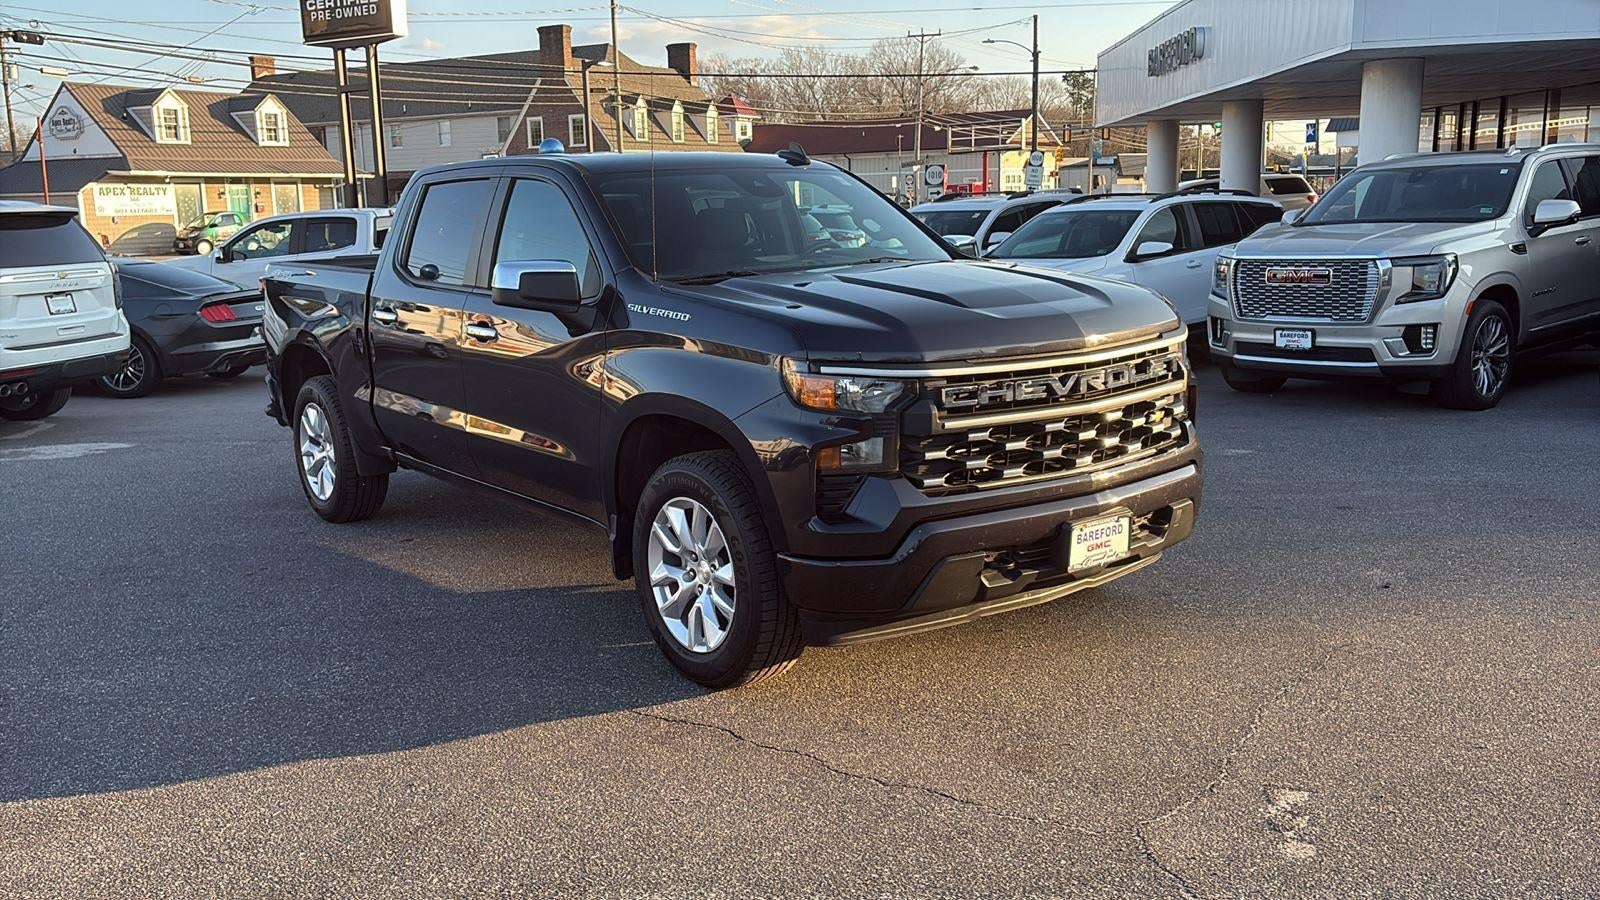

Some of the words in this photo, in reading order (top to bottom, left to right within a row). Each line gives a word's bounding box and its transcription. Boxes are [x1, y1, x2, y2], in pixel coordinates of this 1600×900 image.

[306, 0, 378, 10] CERTIF
[311, 4, 377, 21] PRE-OWNED
[1148, 27, 1205, 77] BAREFORD
[928, 170, 943, 180] 1010
[99, 187, 126, 196] APEX
[130, 187, 167, 196] REALTY
[1268, 269, 1330, 283] GMC
[627, 303, 690, 322] SILVERADO
[942, 354, 1181, 408] CHEVROLET
[1077, 523, 1124, 545] BAREFORD
[1087, 540, 1112, 552] GMC
